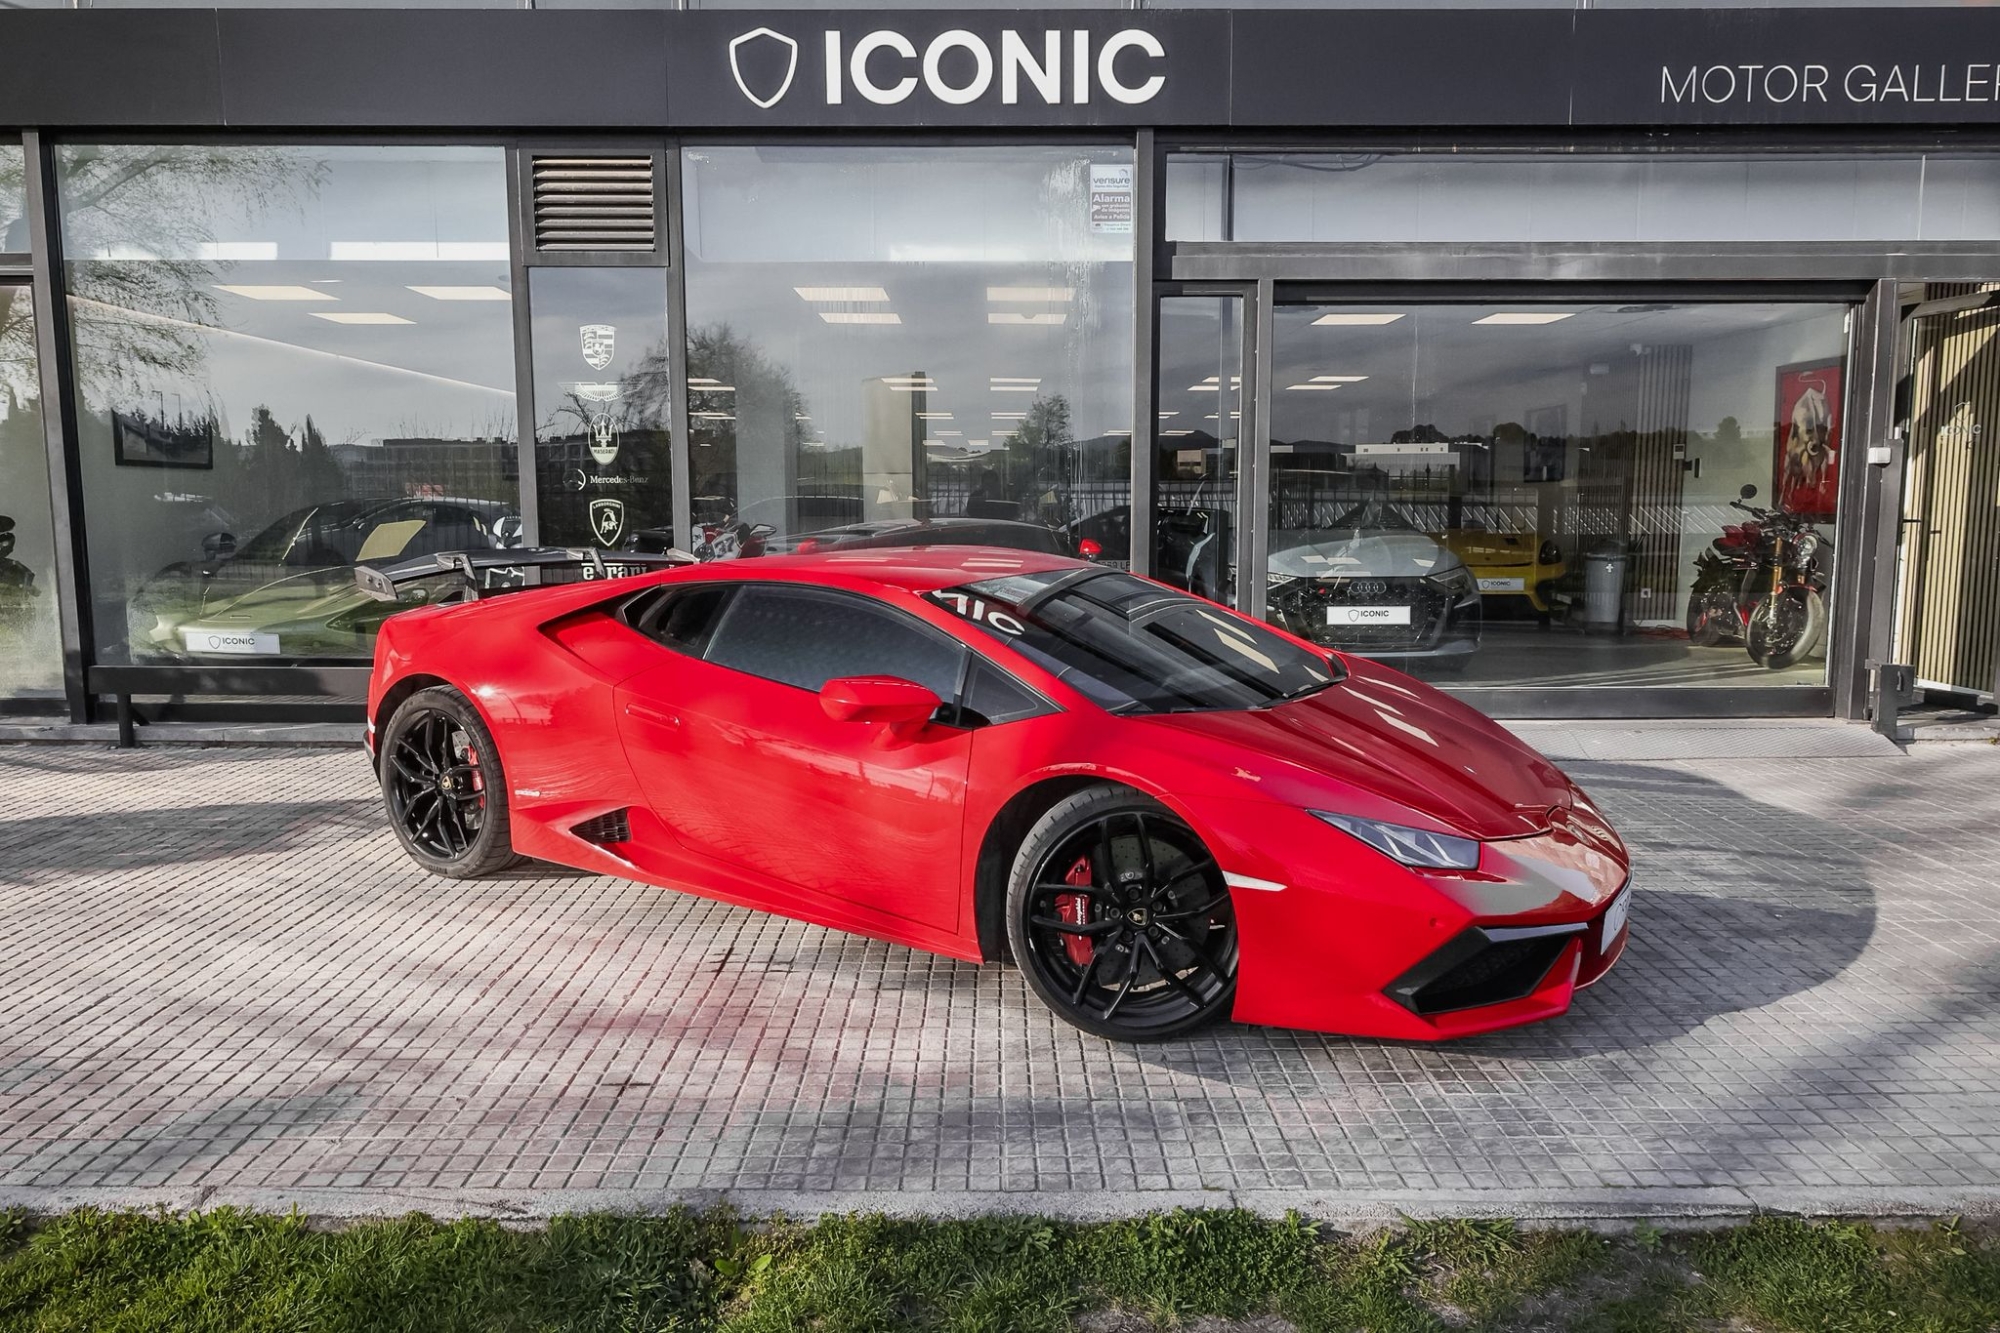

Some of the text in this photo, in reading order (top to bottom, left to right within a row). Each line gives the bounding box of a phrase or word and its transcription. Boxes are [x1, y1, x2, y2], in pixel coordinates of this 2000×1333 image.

[825, 29, 1166, 104] ICONIC
[1661, 64, 1829, 103] MOTOR
[1093, 194, 1131, 203] Alarma
[590, 475, 649, 484] Mercedes-Benz
[222, 637, 255, 645] ICONIC
